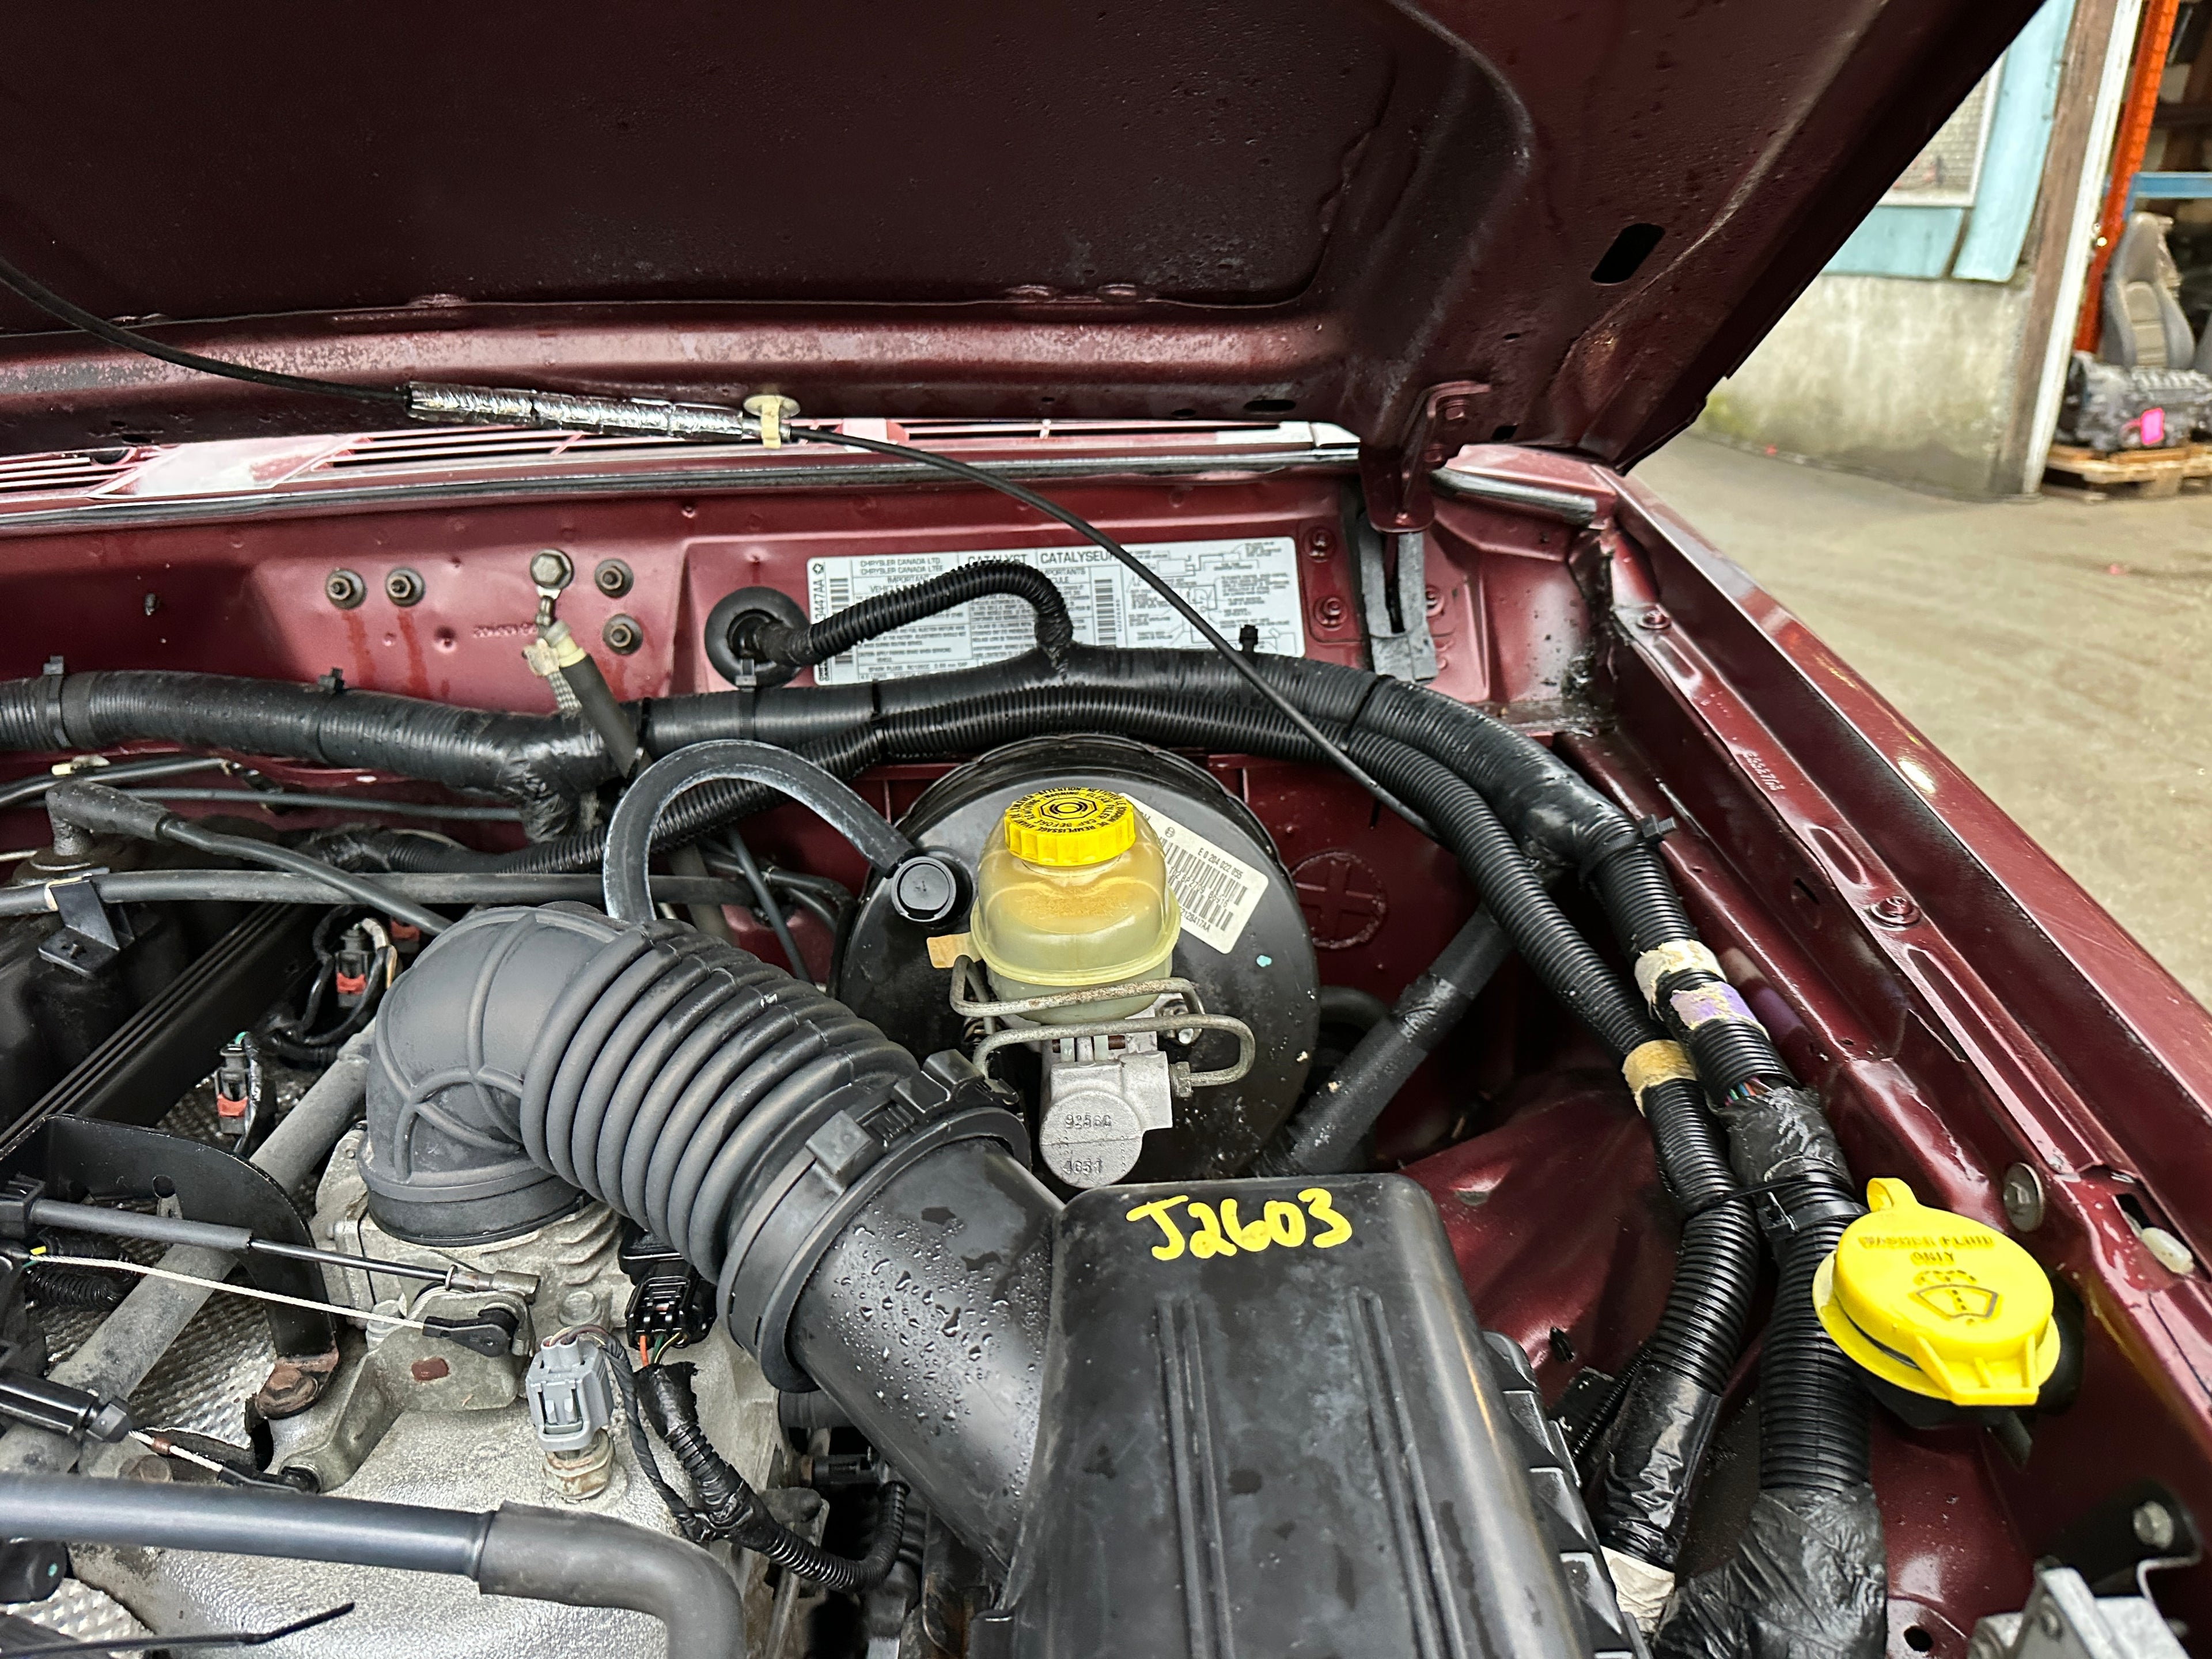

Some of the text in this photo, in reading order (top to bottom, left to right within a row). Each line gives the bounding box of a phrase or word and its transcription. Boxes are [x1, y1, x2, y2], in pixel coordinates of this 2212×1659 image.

[860, 559, 895, 567] CHRYSLER
[861, 567, 896, 575] CHRYSLER
[1198, 848, 1204, 856] E
[1208, 854, 1219, 865] 204
[1219, 861, 1232, 873] 022
[1231, 867, 1243, 879] 055
[1179, 906, 1211, 932] 2128417AA
[1126, 1187, 1353, 1260] J2603
[1939, 1236, 1994, 1247] FLUID
[1910, 1251, 1954, 1266] ONLY
